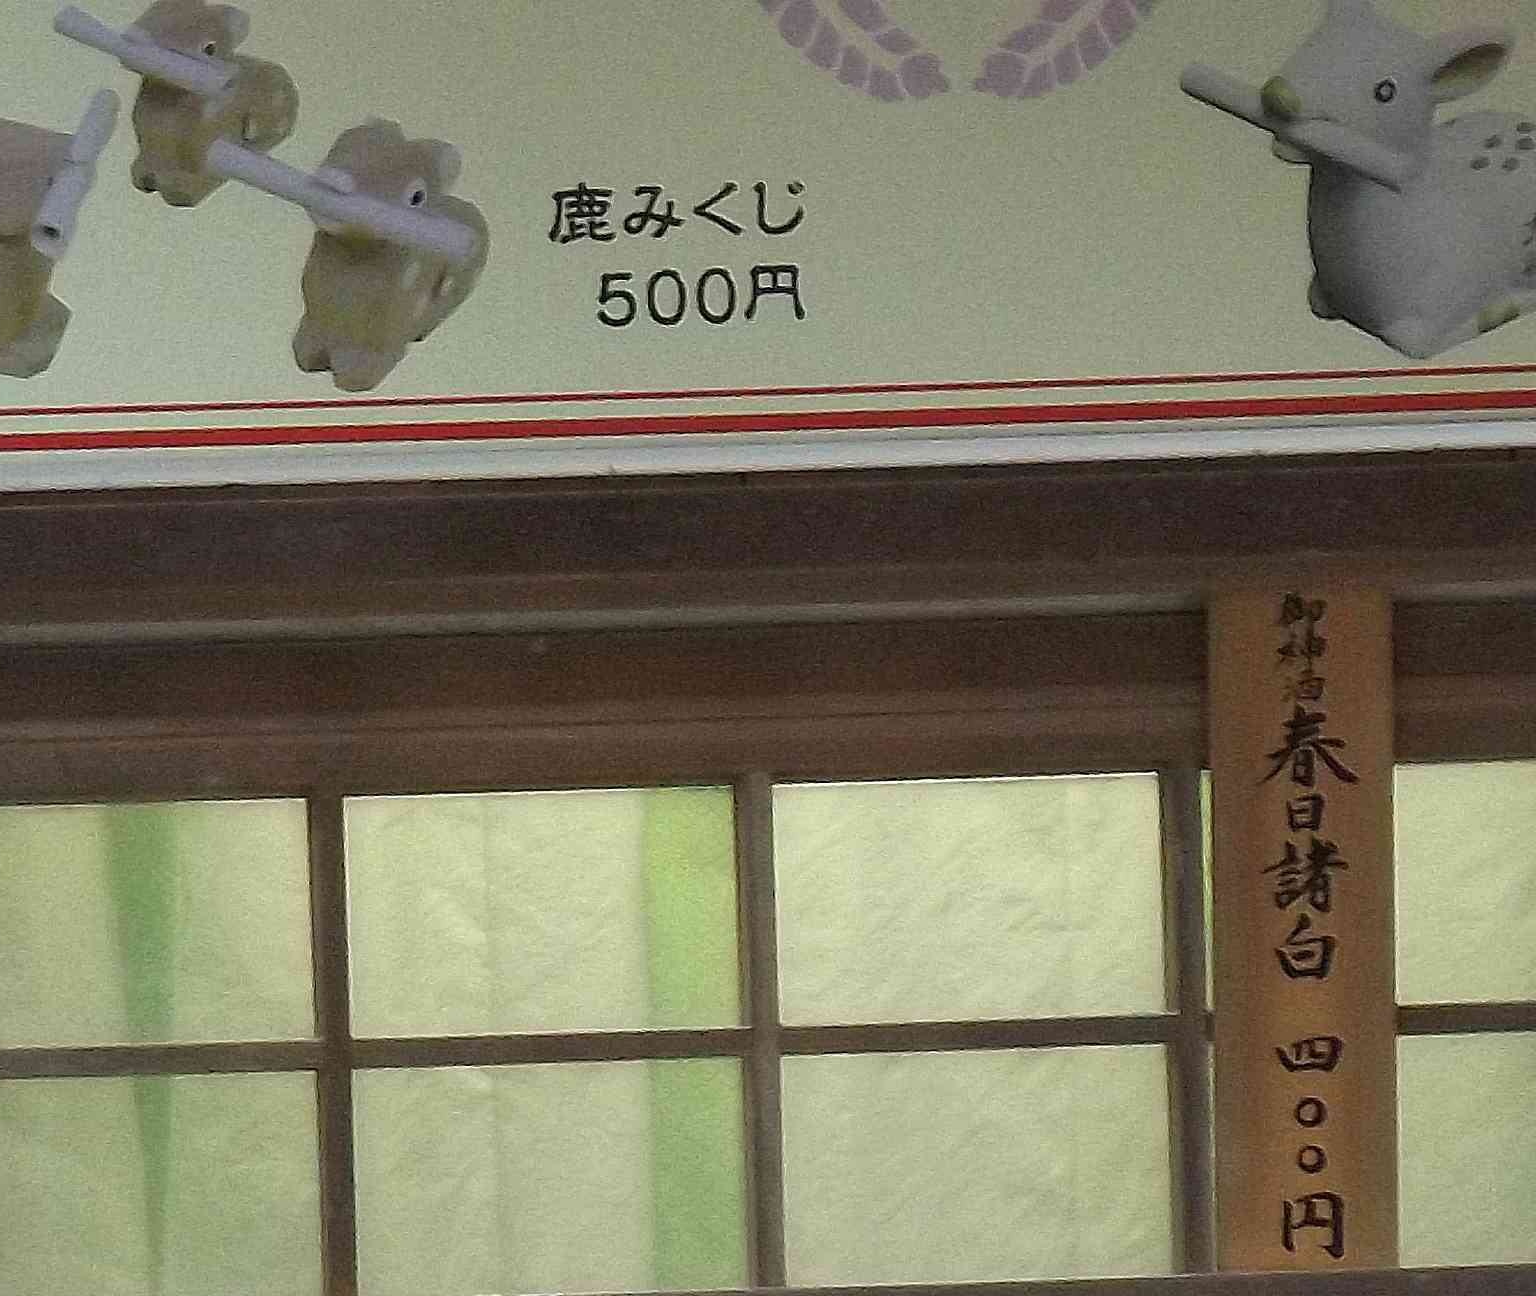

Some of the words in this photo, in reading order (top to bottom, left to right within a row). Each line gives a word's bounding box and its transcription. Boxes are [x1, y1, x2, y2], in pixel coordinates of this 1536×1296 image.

[549, 181, 806, 244] 鹿みくじ
[596, 264, 806, 327] 500円
[1263, 706, 1360, 981] 春日諸白
